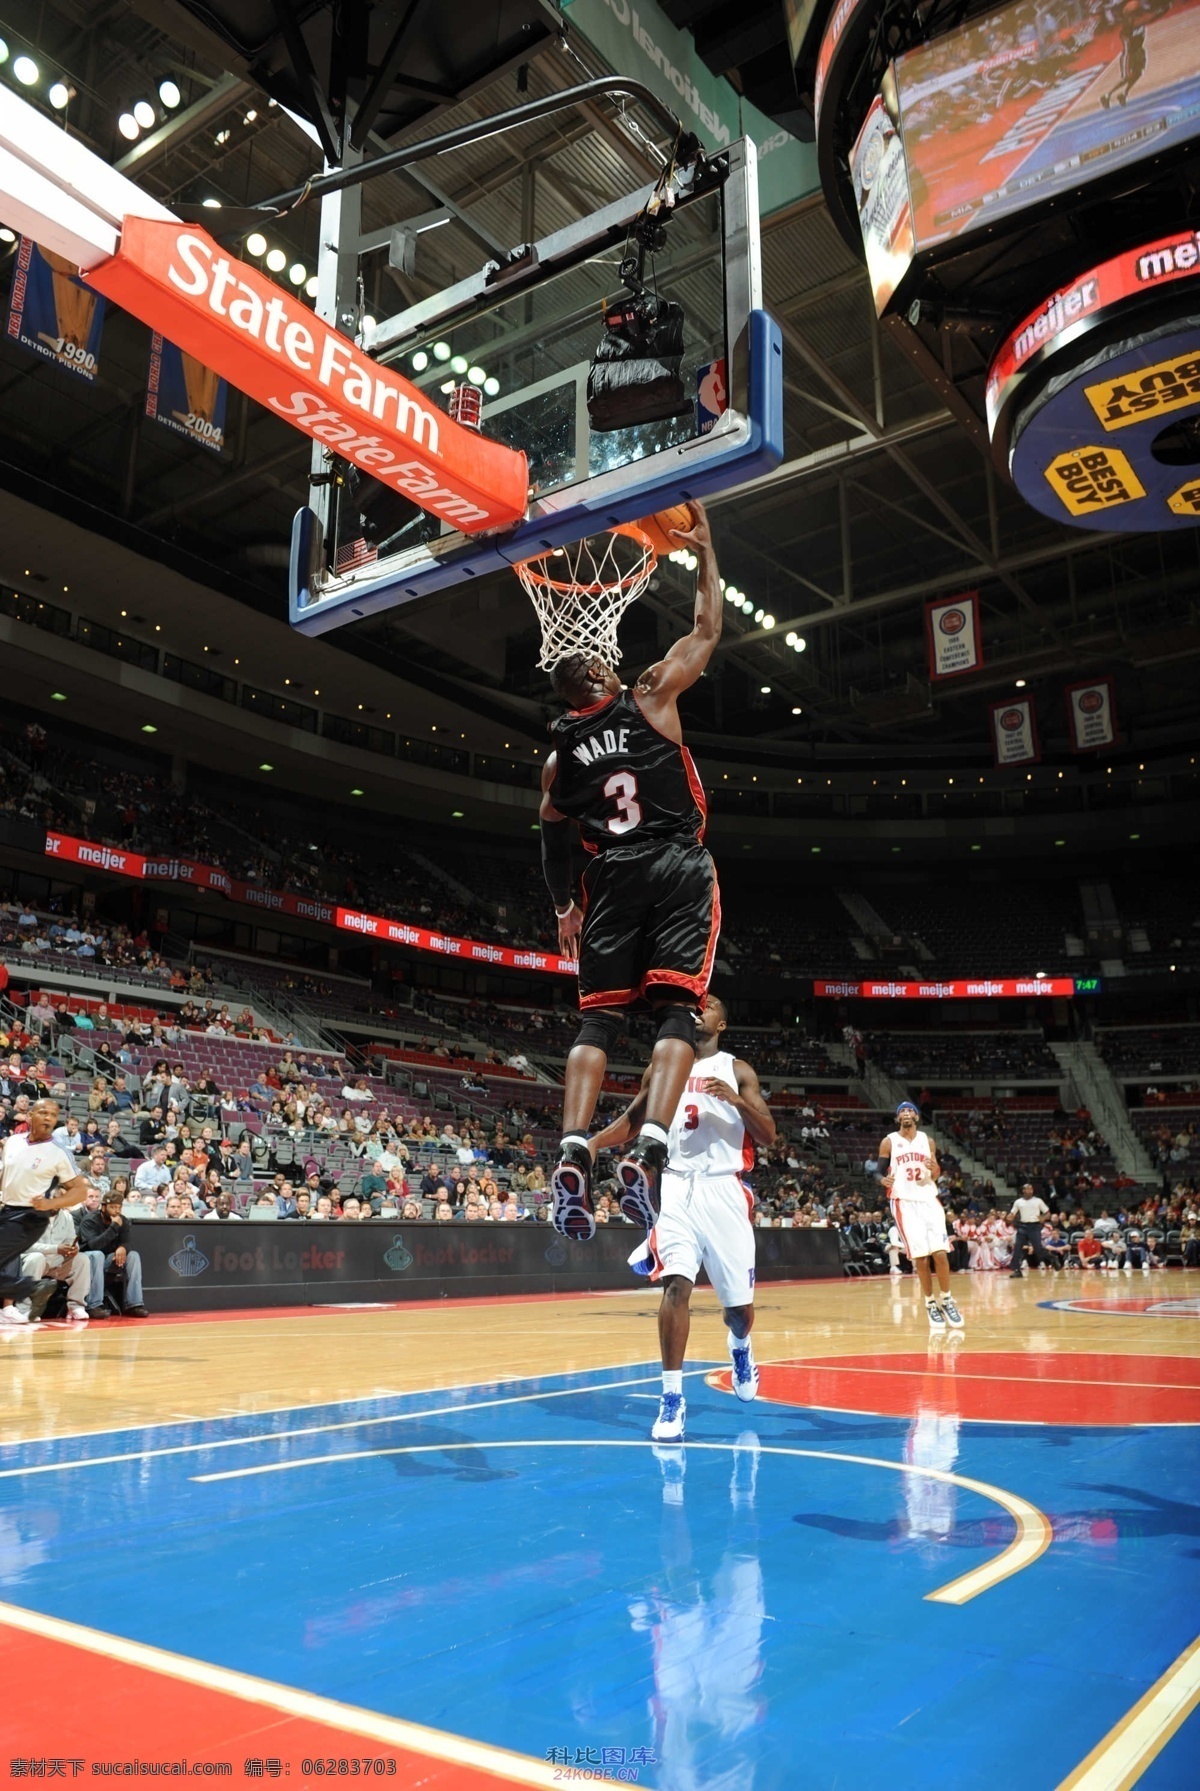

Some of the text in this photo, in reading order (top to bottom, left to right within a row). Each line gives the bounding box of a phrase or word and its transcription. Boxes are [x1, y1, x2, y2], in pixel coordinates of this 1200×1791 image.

[950, 203, 973, 218] MIA
[11, 270, 27, 312] WORLD
[8, 311, 23, 339] NBA
[1014, 278, 1098, 360] meijer
[20, 334, 95, 381] DETROIT PISTONS
[53, 337, 96, 371] 1990
[167, 233, 440, 456] State Farm
[148, 357, 161, 398] WORLD
[146, 398, 157, 420] NBA
[184, 412, 222, 442] 2004
[157, 414, 222, 452] DETROIT PISTONS
[268, 391, 491, 526] State Farm
[1079, 450, 1131, 502] BEST
[1055, 462, 1106, 506] BUY
[572, 729, 630, 767] WADE
[603, 769, 643, 836] 3
[78, 845, 127, 869] meijer
[142, 860, 195, 880] meijer
[246, 889, 285, 908] meijer
[297, 901, 333, 921] meijer
[344, 913, 378, 933] meijer
[388, 924, 420, 944] meijer
[430, 935, 461, 954] meijer
[472, 944, 503, 962] meijer
[513, 952, 547, 969] meijer
[825, 980, 1053, 998] meijer meijer meijer meijer meijer
[1076, 979, 1098, 991] 7:47
[684, 1104, 699, 1130] 3
[896, 1152, 928, 1166] PISTON
[906, 1168, 922, 1182] 32
[212, 1245, 345, 1272] Foot Locker
[416, 1243, 515, 1267] Foot Locker
